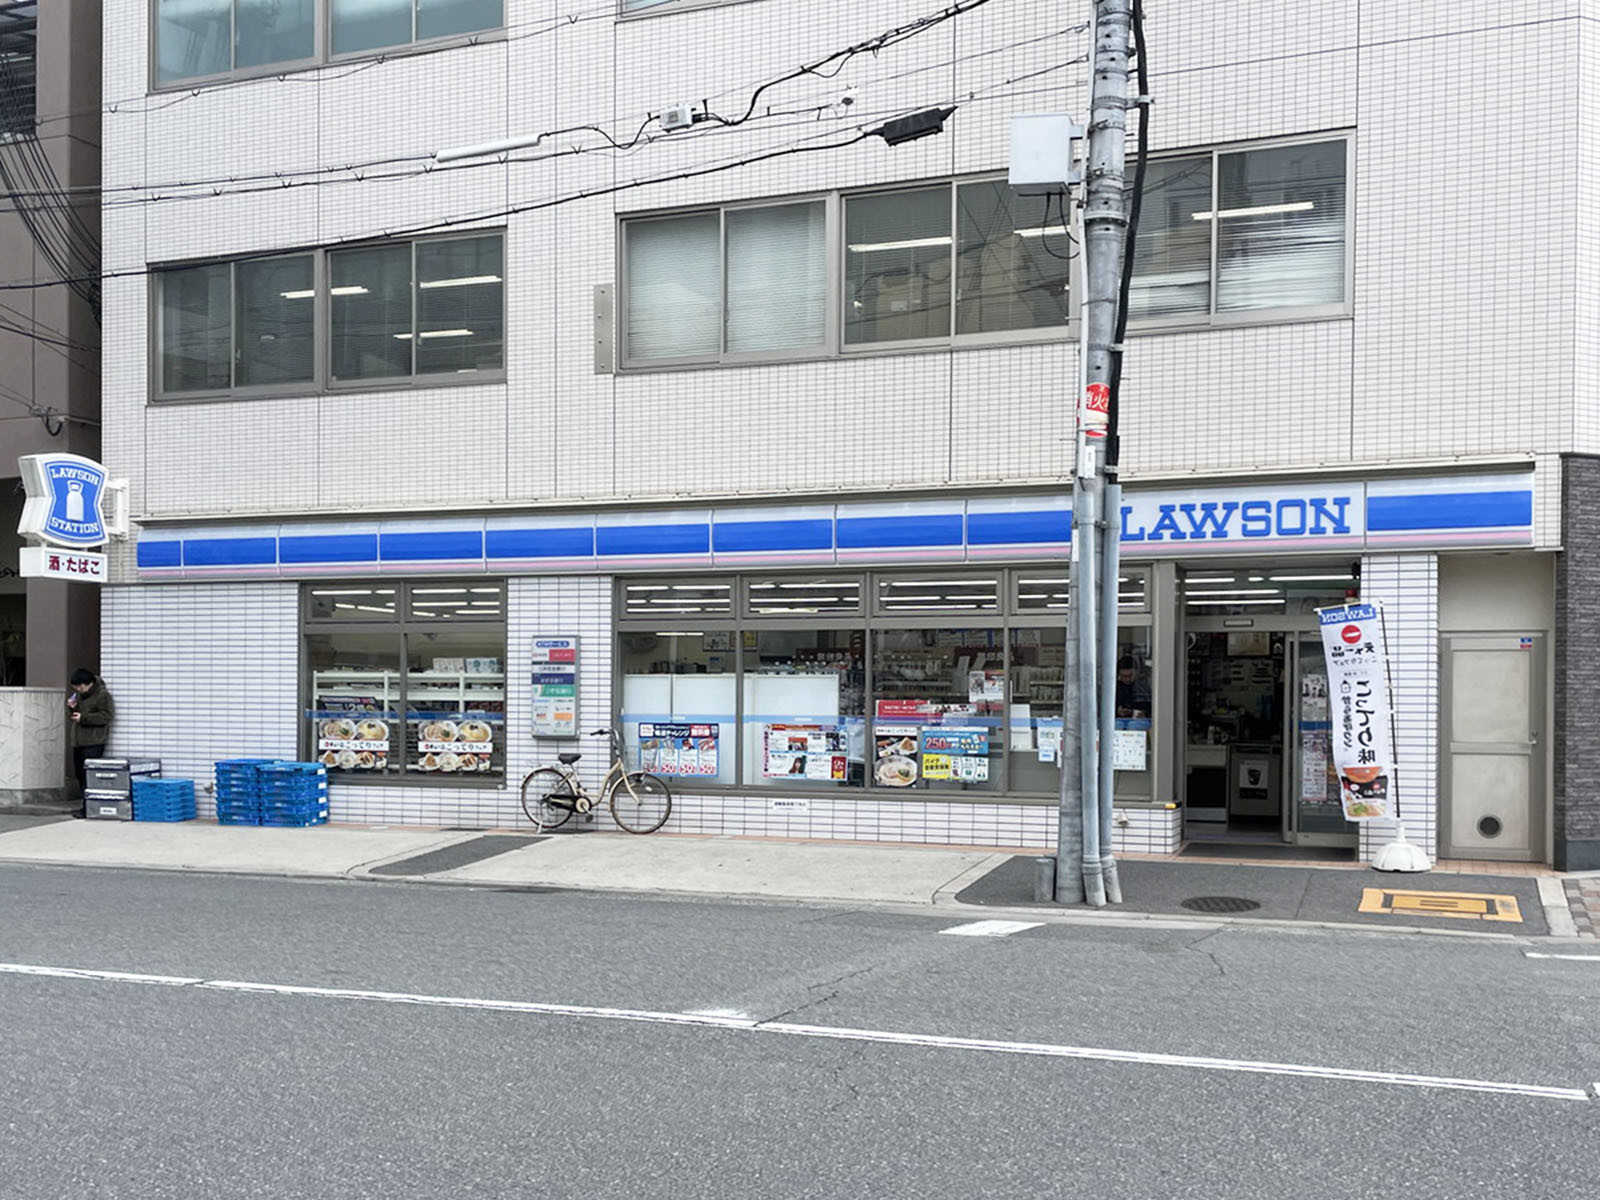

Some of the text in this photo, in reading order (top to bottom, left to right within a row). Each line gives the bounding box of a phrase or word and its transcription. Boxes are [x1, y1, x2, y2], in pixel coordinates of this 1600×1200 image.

[51, 467, 100, 486] LAWSON
[51, 516, 99, 535] STATION
[1120, 497, 1351, 542] LAWSON
[48, 555, 100, 575] 酒・たばこ
[925, 737, 947, 750] 250
